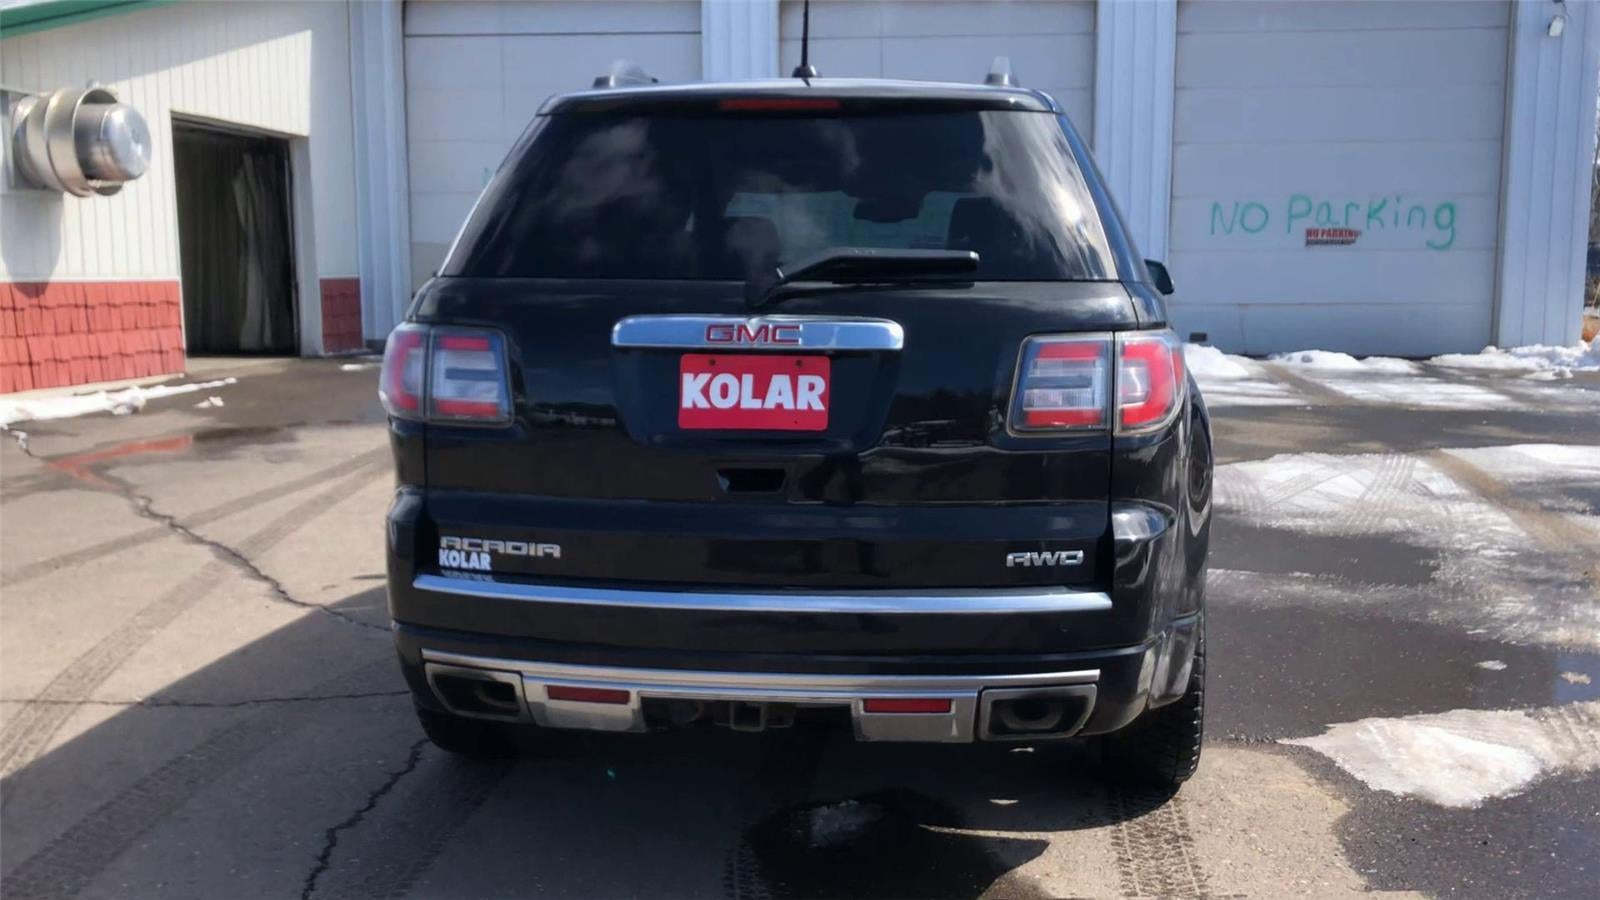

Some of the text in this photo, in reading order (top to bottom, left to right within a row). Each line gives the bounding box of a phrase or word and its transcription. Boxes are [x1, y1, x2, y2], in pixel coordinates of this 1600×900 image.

[1210, 194, 1456, 250] NO Parking
[706, 323, 802, 345] GMC
[681, 372, 826, 411] KOLAR
[440, 536, 561, 558] ACADIA
[438, 548, 492, 571] KOLAR
[1006, 550, 1084, 567] AWD
